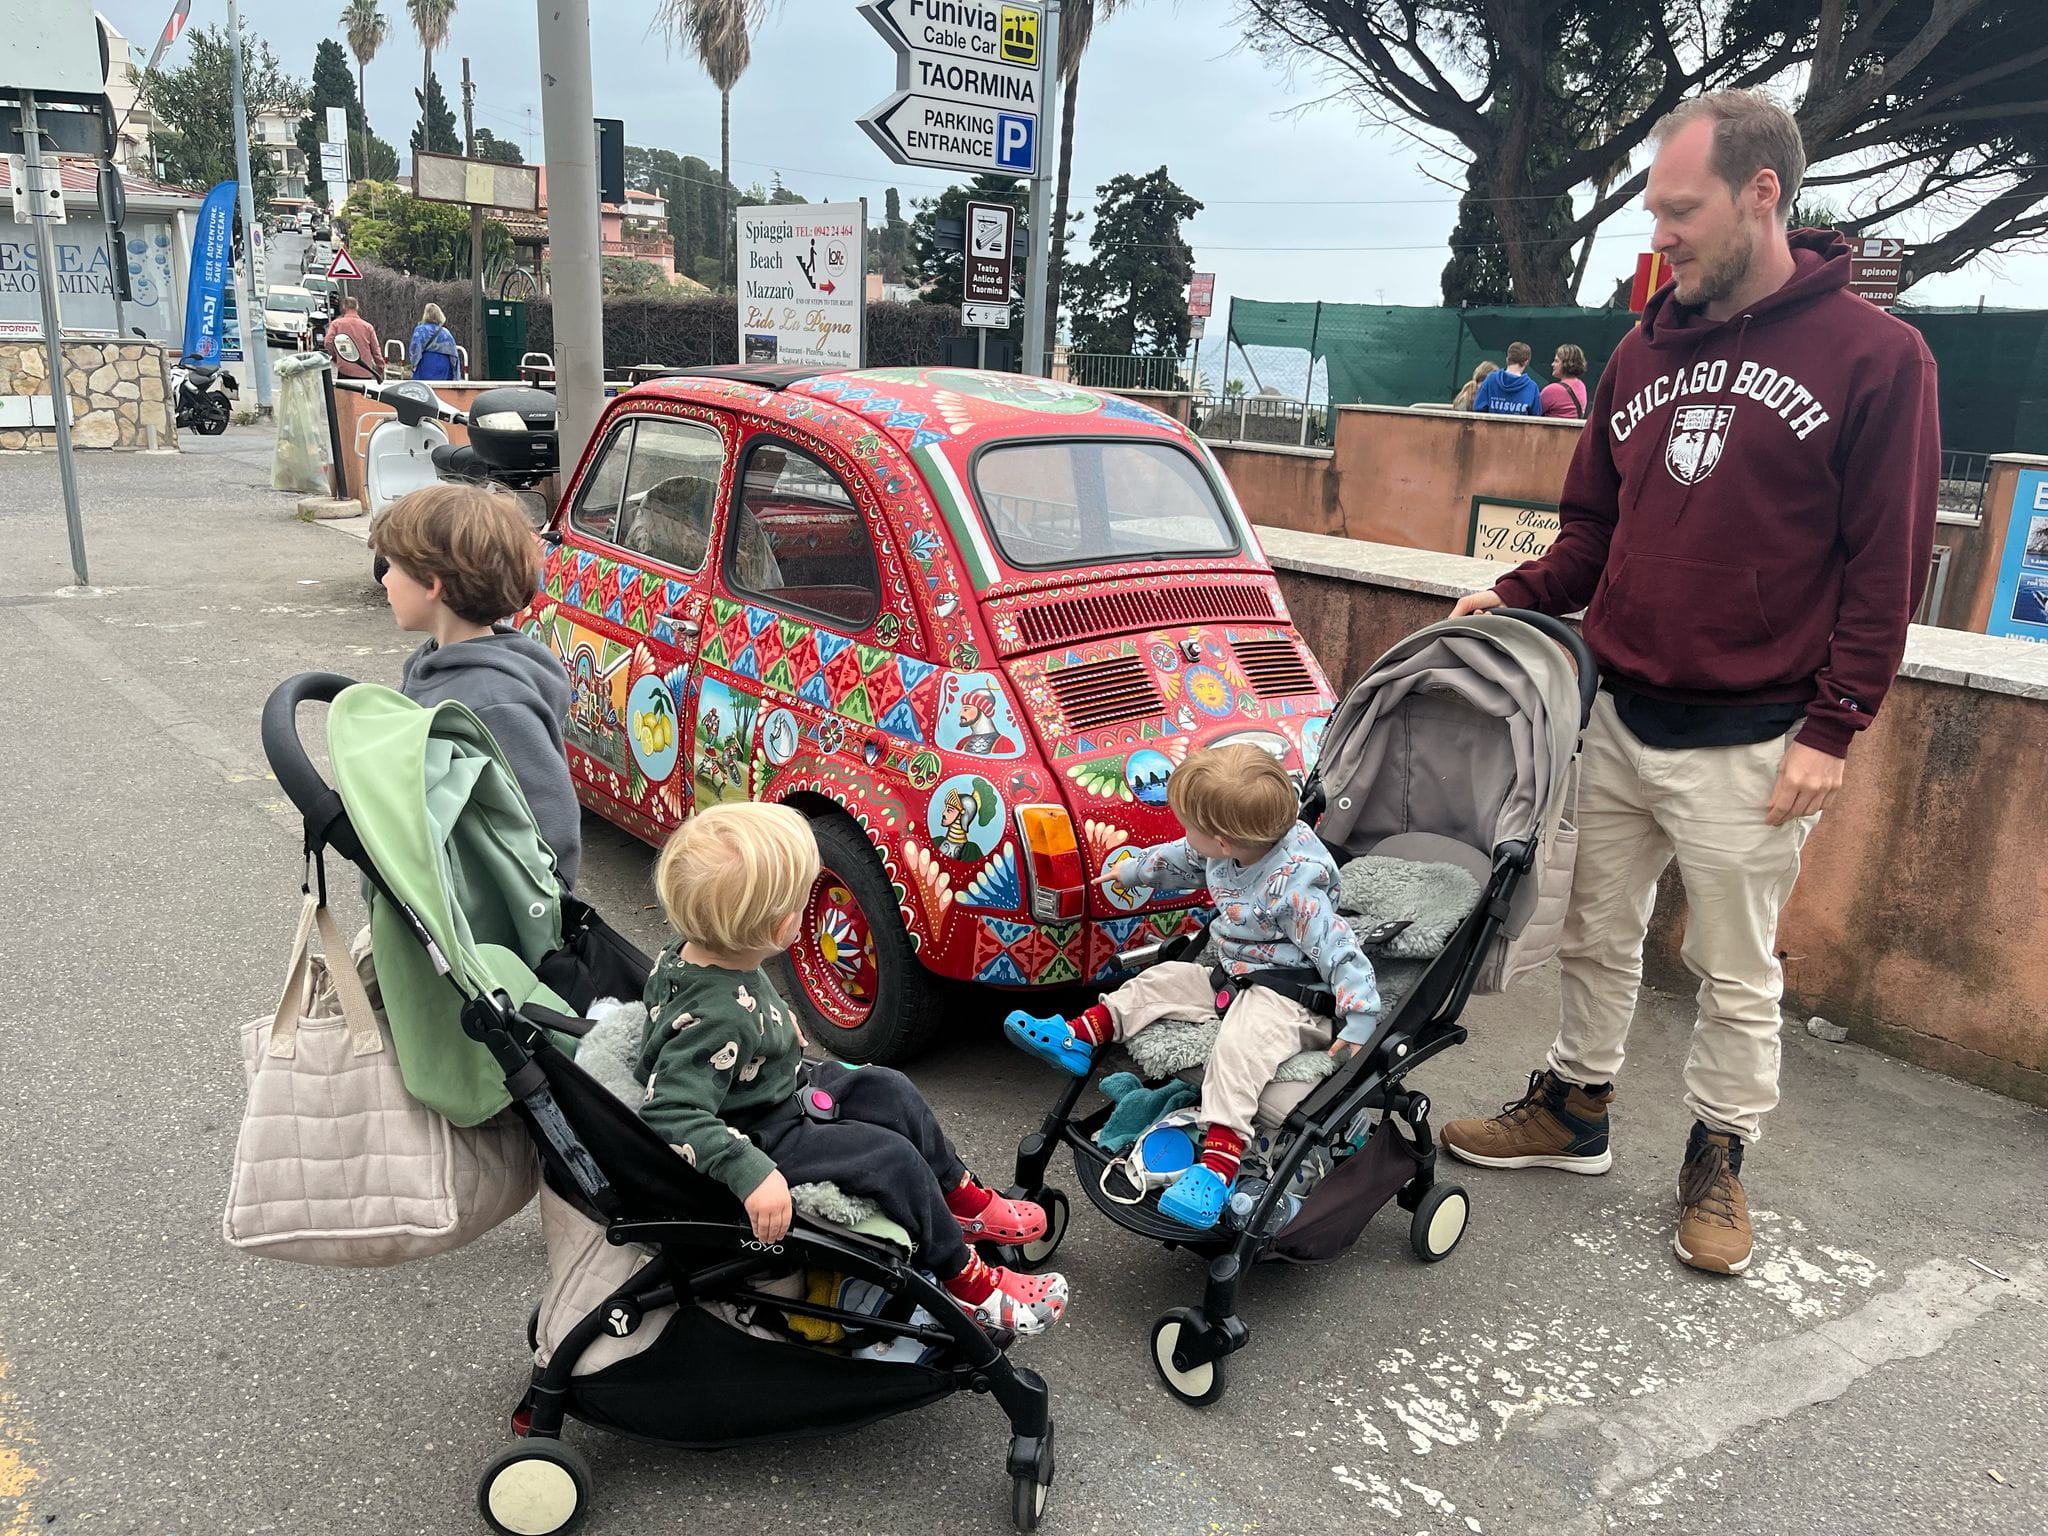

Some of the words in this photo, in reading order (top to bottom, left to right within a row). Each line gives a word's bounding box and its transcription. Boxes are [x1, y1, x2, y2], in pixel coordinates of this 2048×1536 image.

[910, 0, 998, 33] Funivia
[923, 25, 967, 49] Cable
[971, 35, 997, 55] Car
[918, 61, 1035, 103] TAORMINA
[925, 109, 994, 135] PARKING
[907, 130, 993, 157] ENTRANCE
[1003, 119, 1028, 162] P
[746, 220, 793, 244] Spiaggia
[795, 226, 813, 237] TEL:
[814, 225, 830, 237] 0942
[831, 225, 839, 237] 24
[840, 225, 853, 237] 464
[215, 243, 224, 259] THE
[750, 250, 783, 269] Beach
[205, 260, 214, 281] SEEK
[213, 262, 222, 283] SAVE
[976, 263, 1000, 273] Teatro
[1861, 267, 1898, 278] spisone
[971, 284, 1003, 295] Taormina
[972, 273, 994, 284] Antico
[995, 275, 1003, 285] di
[746, 280, 794, 300] Mazzarò
[1860, 291, 1894, 300] mazzeo
[202, 295, 217, 336] PADI
[744, 305, 775, 330] Lido
[803, 309, 852, 352] Pigna
[1490, 400, 1529, 413] LEISURE
[1610, 359, 1728, 442] CHICAGO
[1731, 360, 1830, 441] BOOTH
[1516, 509, 1561, 531] Risto
[1510, 530, 1546, 557] Ba
[739, 1237, 784, 1255] YOYO
